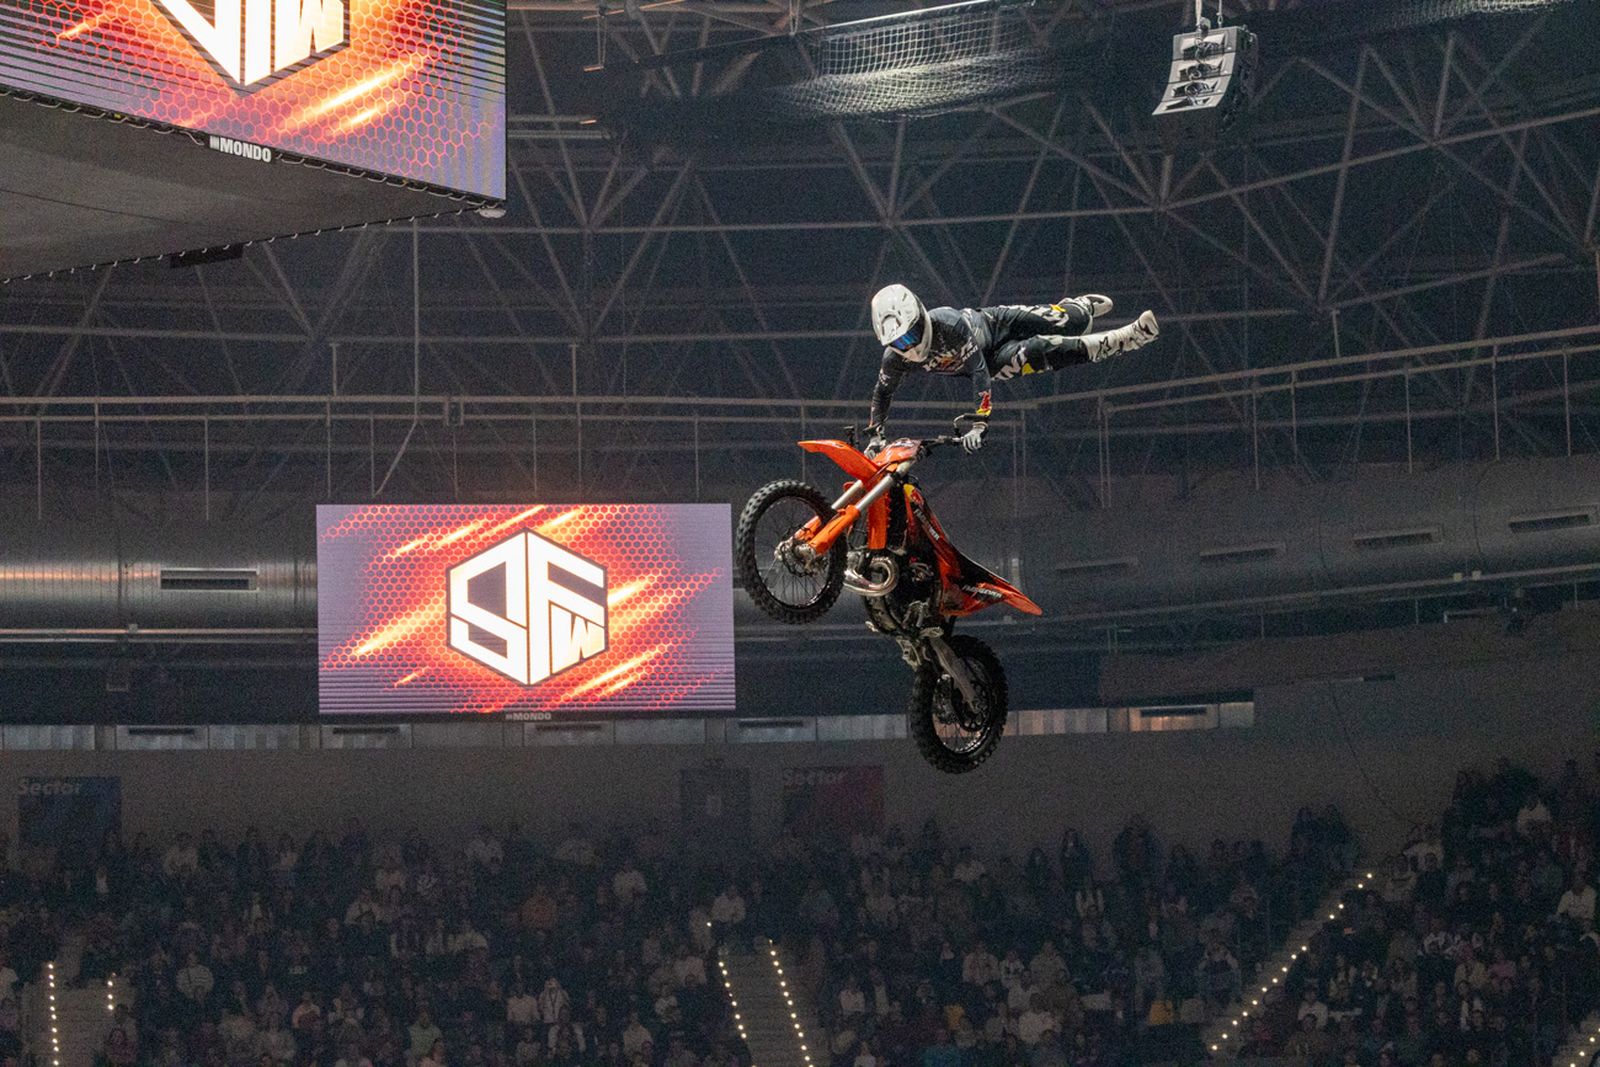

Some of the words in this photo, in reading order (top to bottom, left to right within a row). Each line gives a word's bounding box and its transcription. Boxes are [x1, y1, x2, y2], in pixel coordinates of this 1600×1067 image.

[220, 137, 272, 163] MONDO
[512, 712, 552, 721] MONDO
[18, 778, 82, 796] Sector
